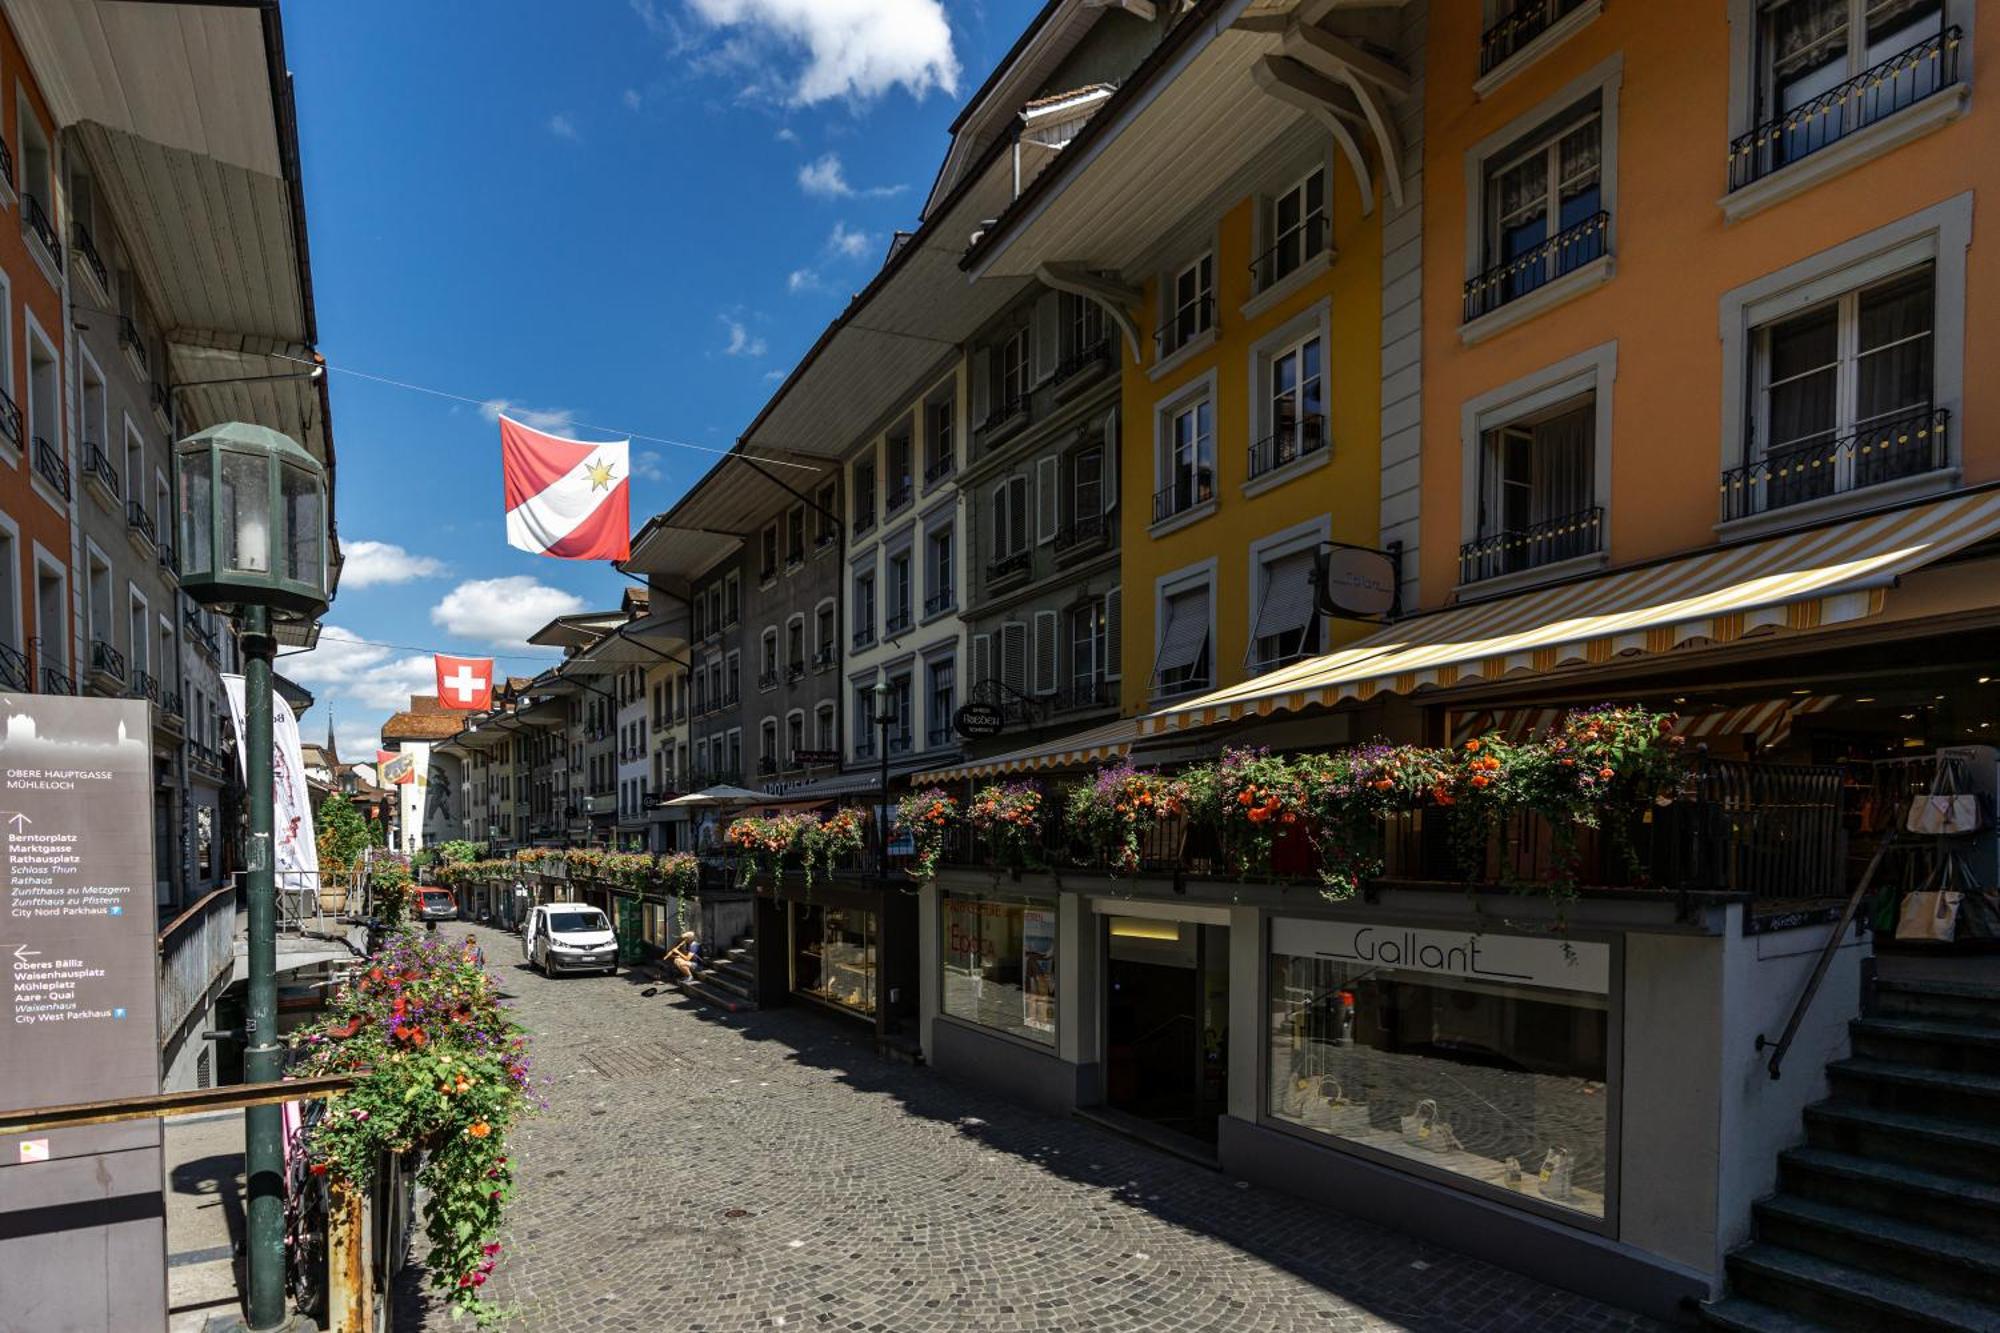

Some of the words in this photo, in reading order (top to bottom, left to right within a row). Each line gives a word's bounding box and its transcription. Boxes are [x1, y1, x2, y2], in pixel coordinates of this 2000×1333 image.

[7, 769, 41, 778] OBERE
[44, 770, 113, 780] HAUPTGASSE
[7, 779, 75, 790] MÜHLELOCH
[8, 833, 78, 844] Berntorplatz
[9, 844, 72, 854] Marktgasse
[9, 854, 81, 864] Rathausplatz
[10, 865, 48, 874] Schloss
[51, 865, 77, 874] Thun
[10, 876, 53, 885] Rathaus
[11, 887, 64, 897] Zunfthaus
[82, 886, 130, 896] Metzgern
[11, 897, 65, 907] Zunfthaus
[82, 896, 120, 905] Pfistern
[12, 908, 32, 918] City
[34, 907, 60, 916] Nord
[63, 906, 107, 916] Parkhaus
[1354, 928, 1492, 974] Gallant
[13, 961, 52, 970] Oberes
[55, 959, 84, 968] Bälliz
[14, 968, 105, 981] Waisenhausplatz
[14, 981, 76, 992] Mühleplatz
[15, 993, 41, 1002] Aare
[49, 991, 74, 1001] Quai
[15, 1002, 76, 1013] Waisenhaus
[15, 1014, 35, 1024] City
[38, 1012, 64, 1022] West
[67, 1009, 111, 1020] Parkhaus
